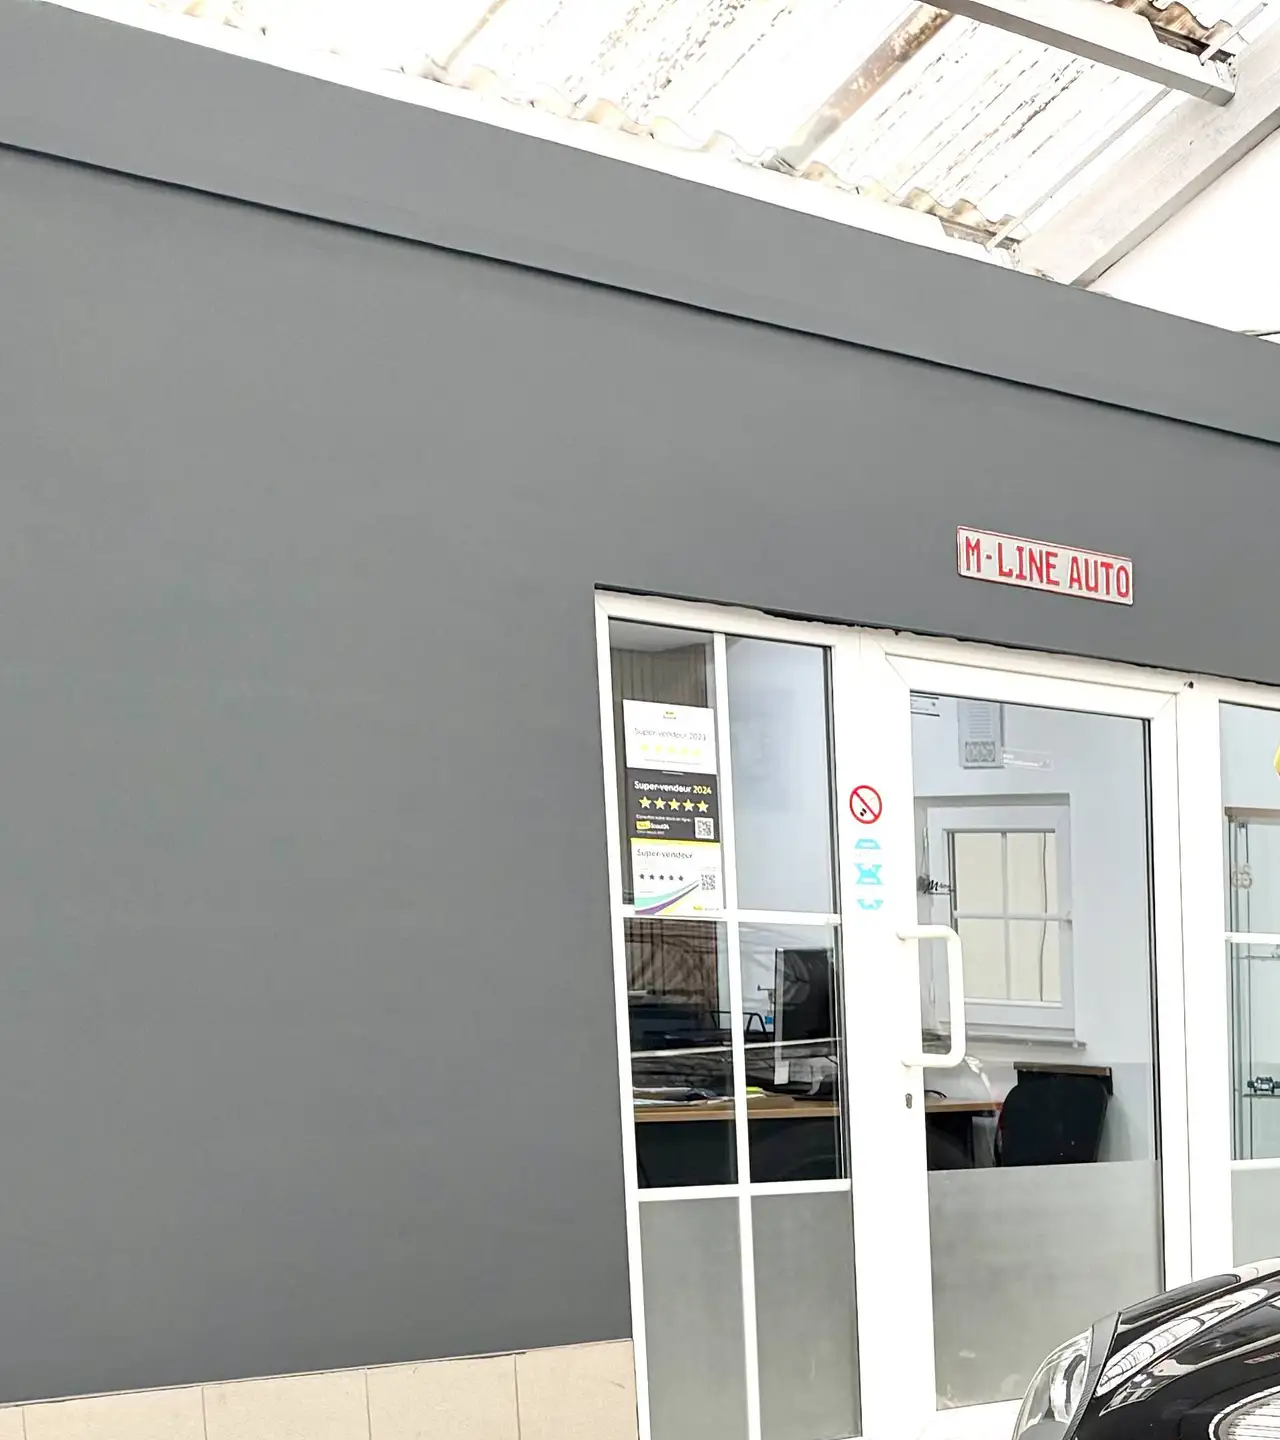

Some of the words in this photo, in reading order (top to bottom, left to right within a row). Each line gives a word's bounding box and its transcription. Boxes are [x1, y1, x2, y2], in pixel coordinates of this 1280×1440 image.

[965, 535, 1060, 586] M-LINE
[1068, 555, 1131, 598] AUTO
[634, 780, 692, 793] Super-vendeur
[693, 785, 713, 795] 2024
